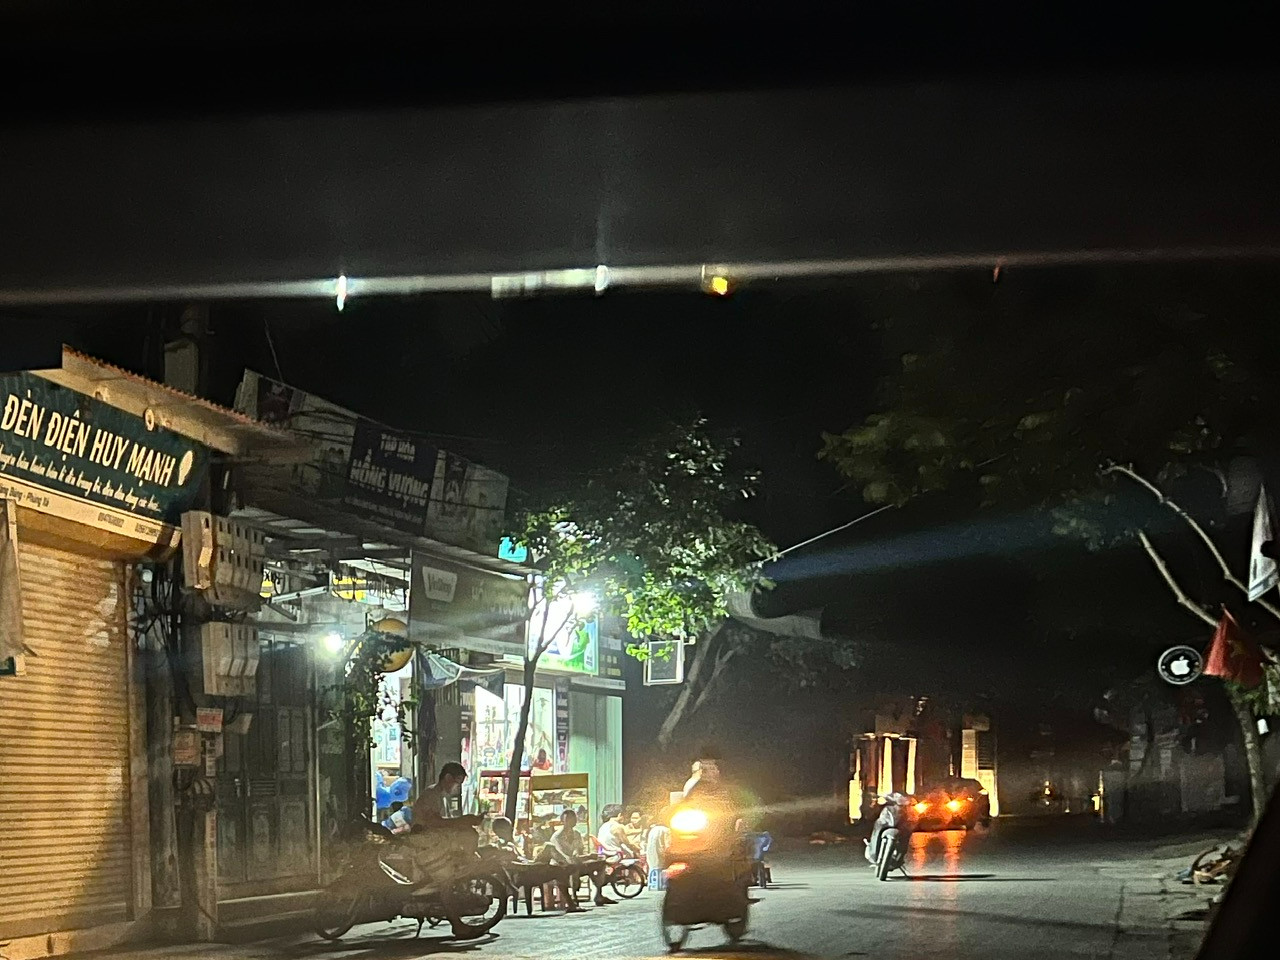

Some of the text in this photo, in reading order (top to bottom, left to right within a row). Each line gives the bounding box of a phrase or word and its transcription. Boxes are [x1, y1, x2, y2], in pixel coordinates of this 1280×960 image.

[0, 390, 176, 487] ĐÈN ĐIỆN HUY MẠNH
